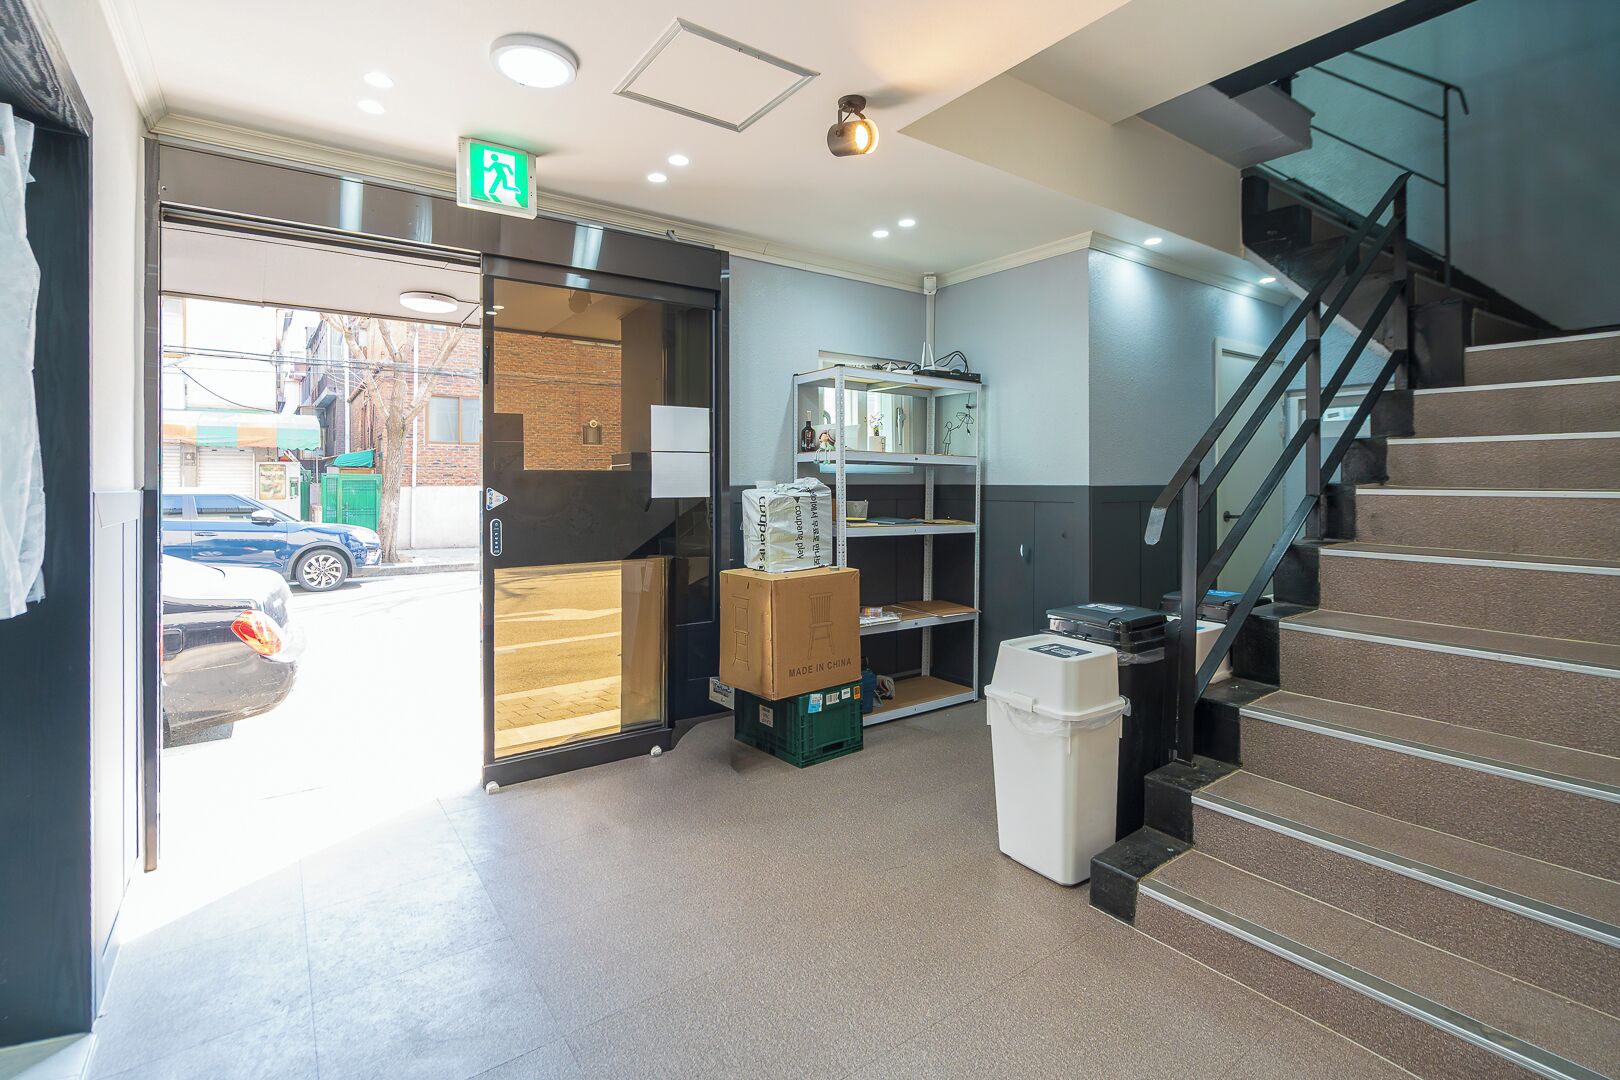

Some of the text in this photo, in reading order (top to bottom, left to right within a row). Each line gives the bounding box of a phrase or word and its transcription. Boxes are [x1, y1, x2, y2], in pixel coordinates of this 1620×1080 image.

[795, 505, 805, 559] coupang play
[811, 520, 820, 542] 무료로
[789, 658, 852, 677] MADE IN CHINA
